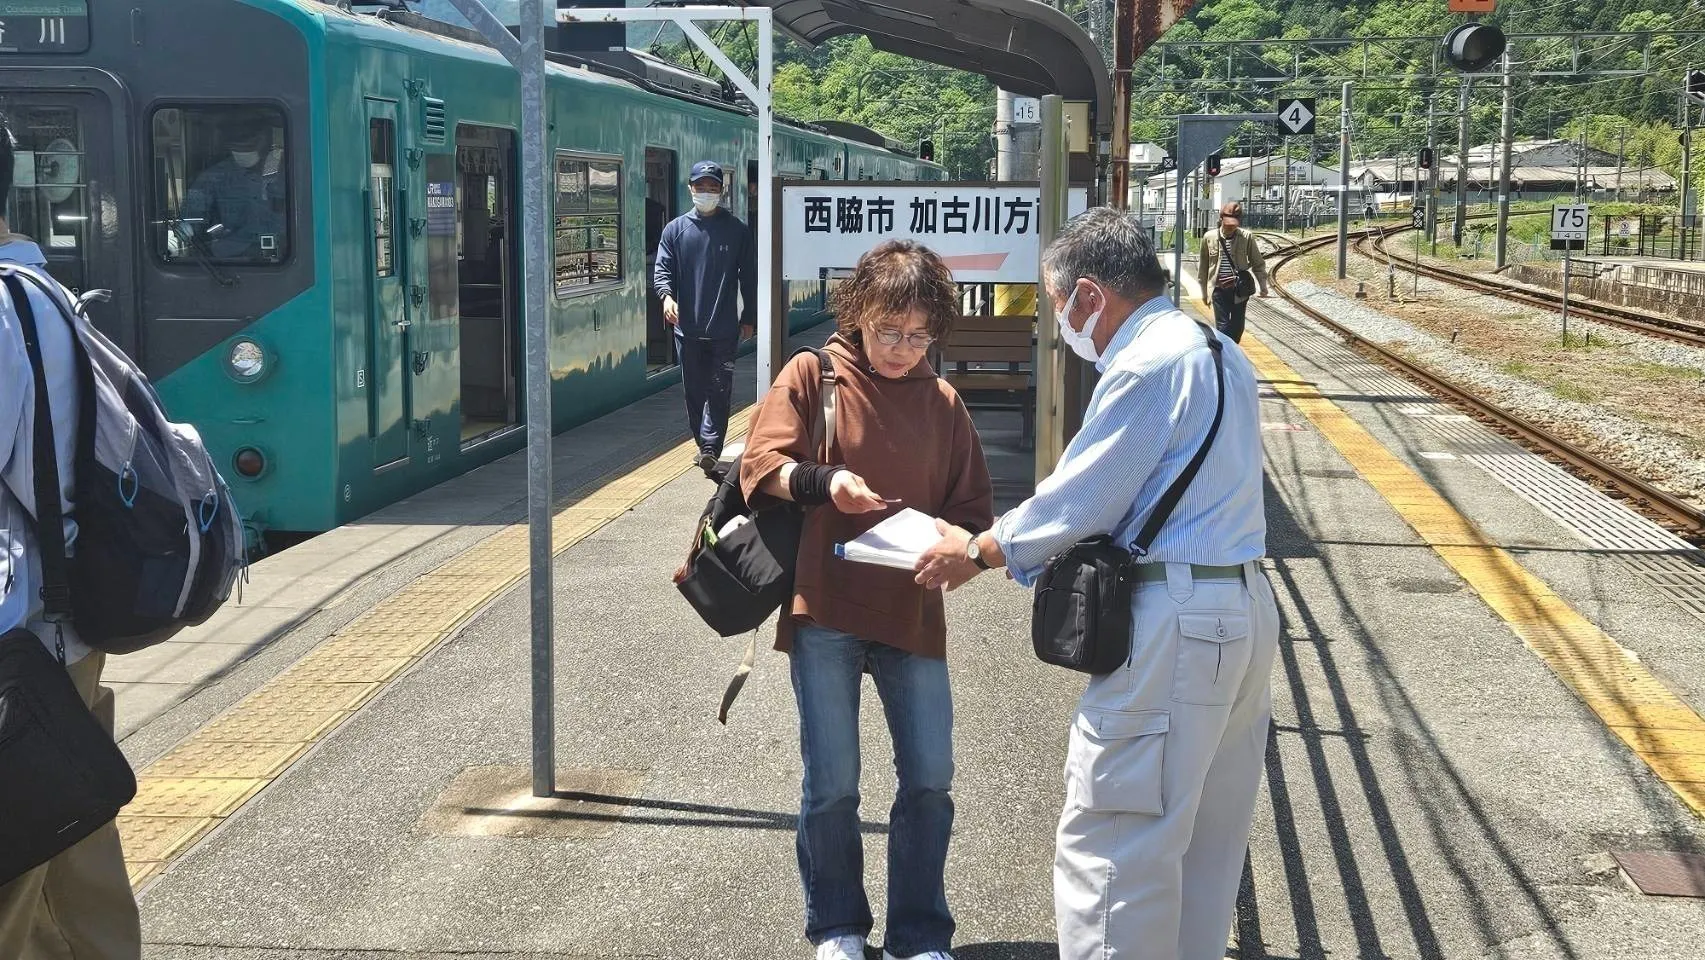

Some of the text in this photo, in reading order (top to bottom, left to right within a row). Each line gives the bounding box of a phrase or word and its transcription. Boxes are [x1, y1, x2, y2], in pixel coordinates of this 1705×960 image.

[1020, 106, 1034, 119] 15
[1288, 107, 1302, 125] 4
[804, 195, 1040, 234] 西脇市 加古川方
[1557, 208, 1585, 228] 75
